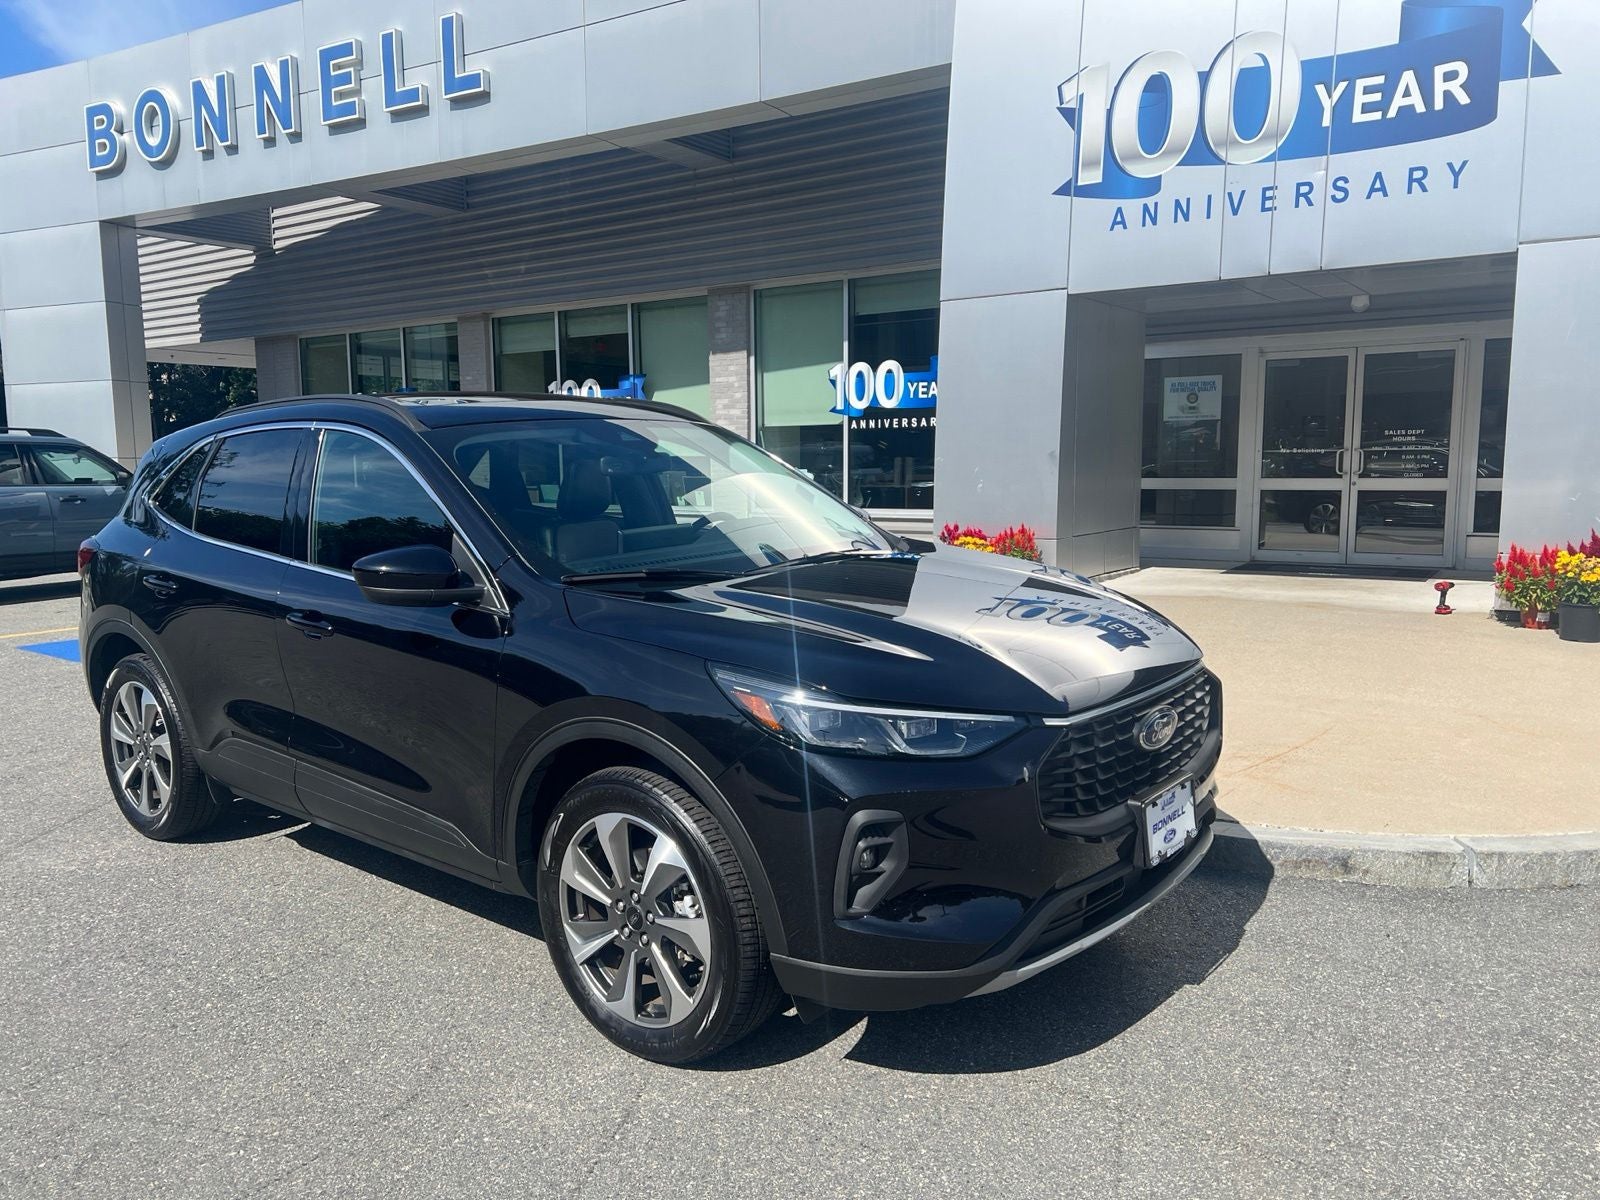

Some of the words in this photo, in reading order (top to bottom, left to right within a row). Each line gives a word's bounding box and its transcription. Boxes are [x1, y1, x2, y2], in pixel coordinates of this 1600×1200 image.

[84, 12, 490, 174] BONNELL
[1058, 30, 1302, 187] 100
[1313, 61, 1471, 128] YEAR
[1109, 159, 1470, 231] ANNIVERSARY
[828, 360, 905, 409] 100
[908, 382, 938, 398] YEA
[851, 417, 937, 429] ANNIVERSAR
[1152, 805, 1186, 835] BONNELL
